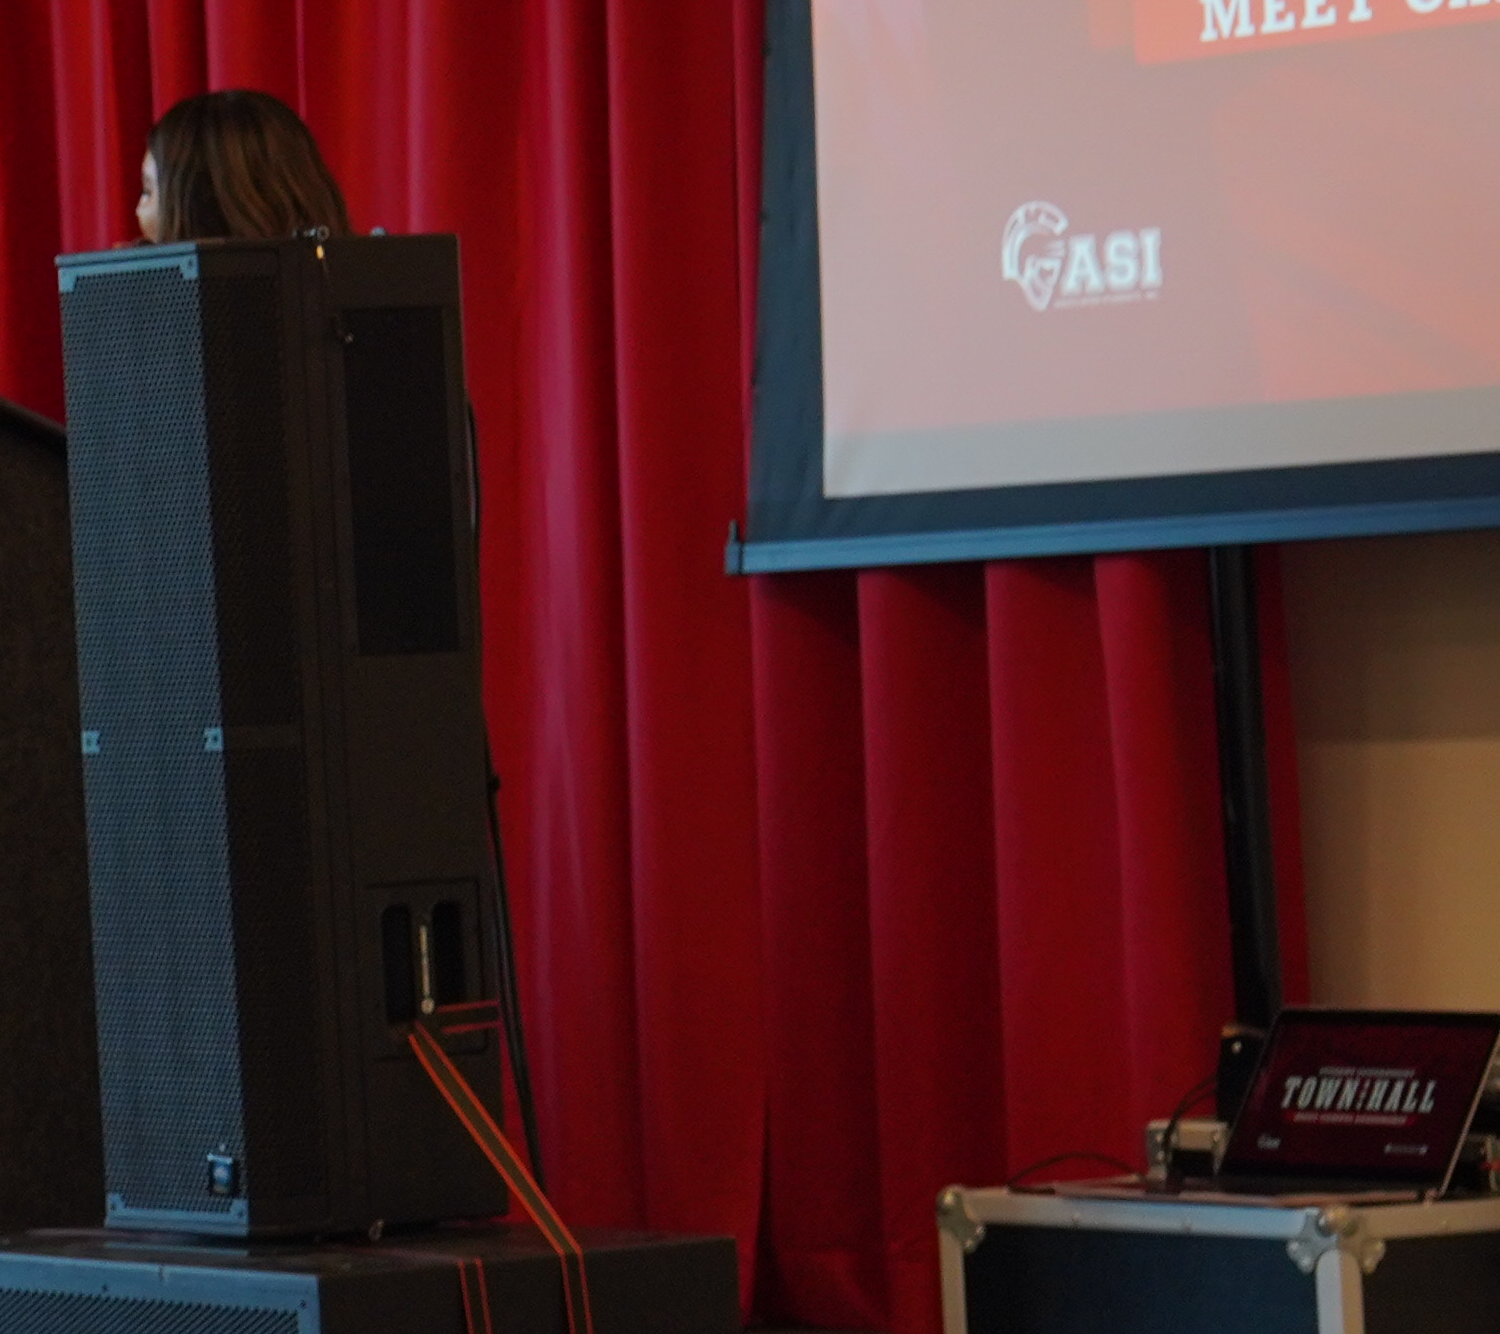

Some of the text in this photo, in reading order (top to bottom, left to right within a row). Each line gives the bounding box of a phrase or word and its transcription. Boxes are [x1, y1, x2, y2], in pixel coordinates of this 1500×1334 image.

[1061, 226, 1164, 297] ASI
[1281, 1075, 1437, 1114] TOWN HALL
